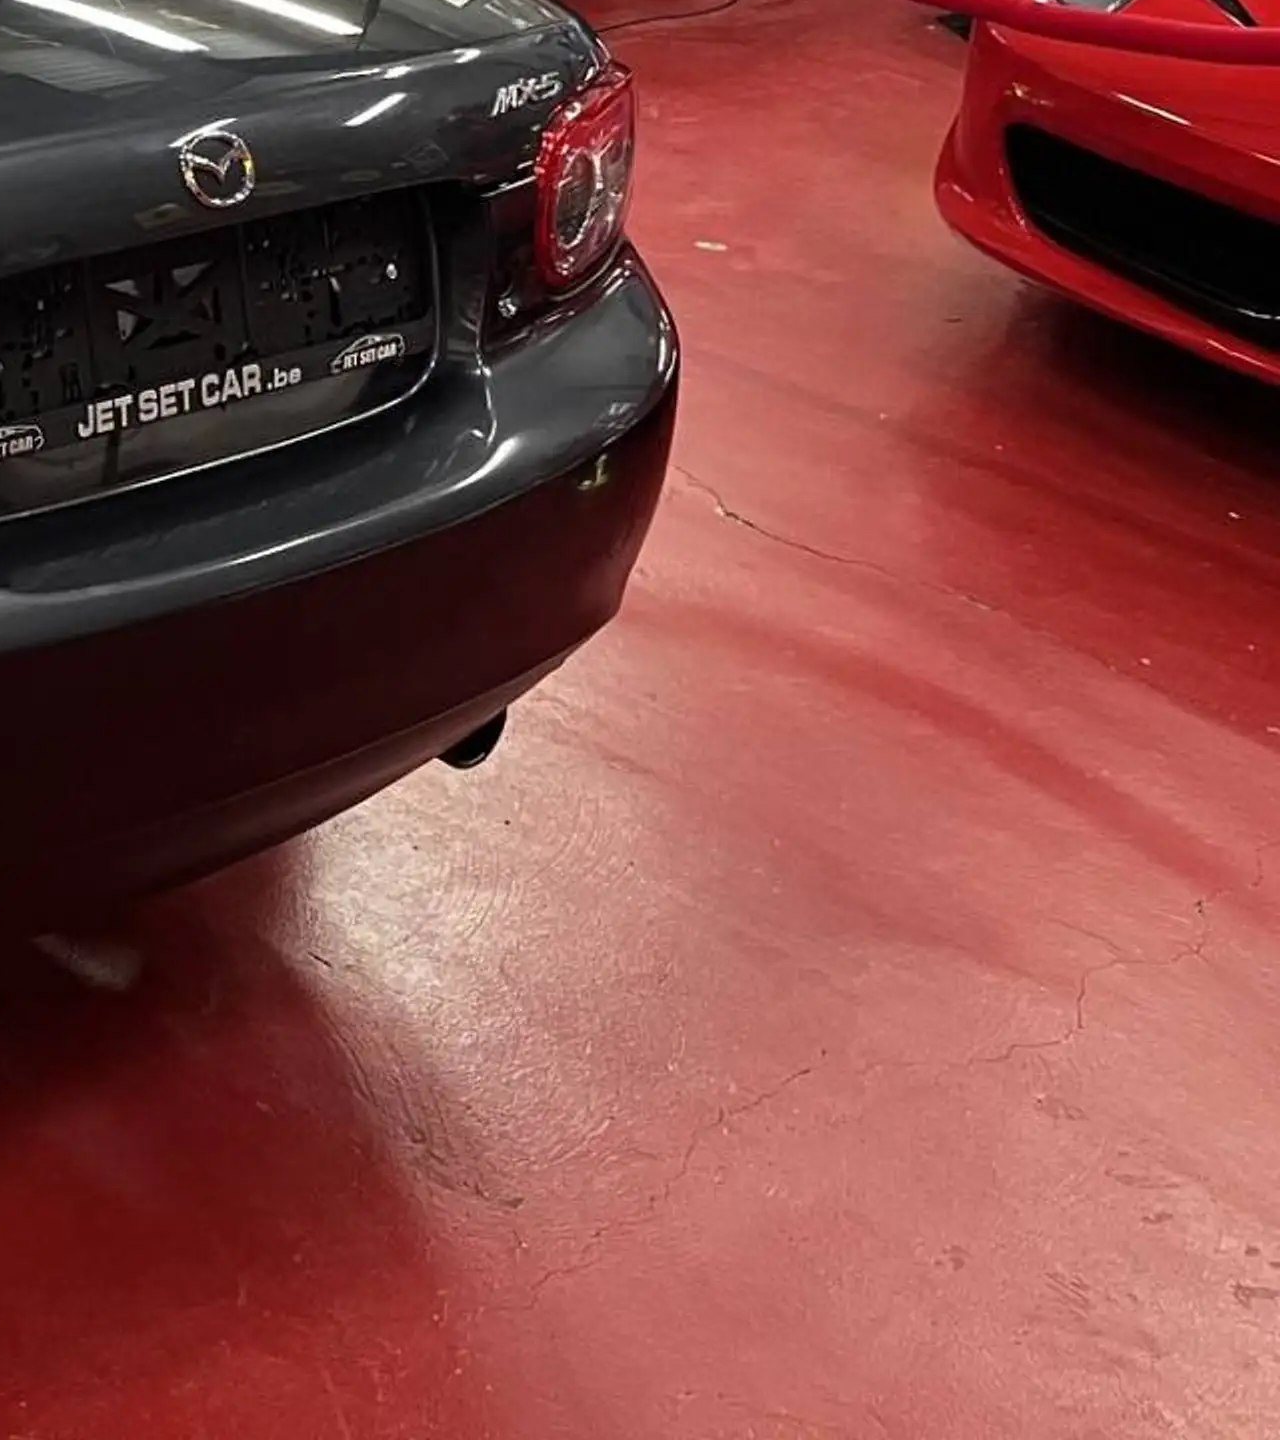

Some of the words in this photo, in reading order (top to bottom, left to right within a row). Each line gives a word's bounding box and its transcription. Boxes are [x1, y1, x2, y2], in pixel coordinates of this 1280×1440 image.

[490, 71, 564, 118] MX-5
[77, 393, 134, 438] JET
[137, 377, 196, 423] SET
